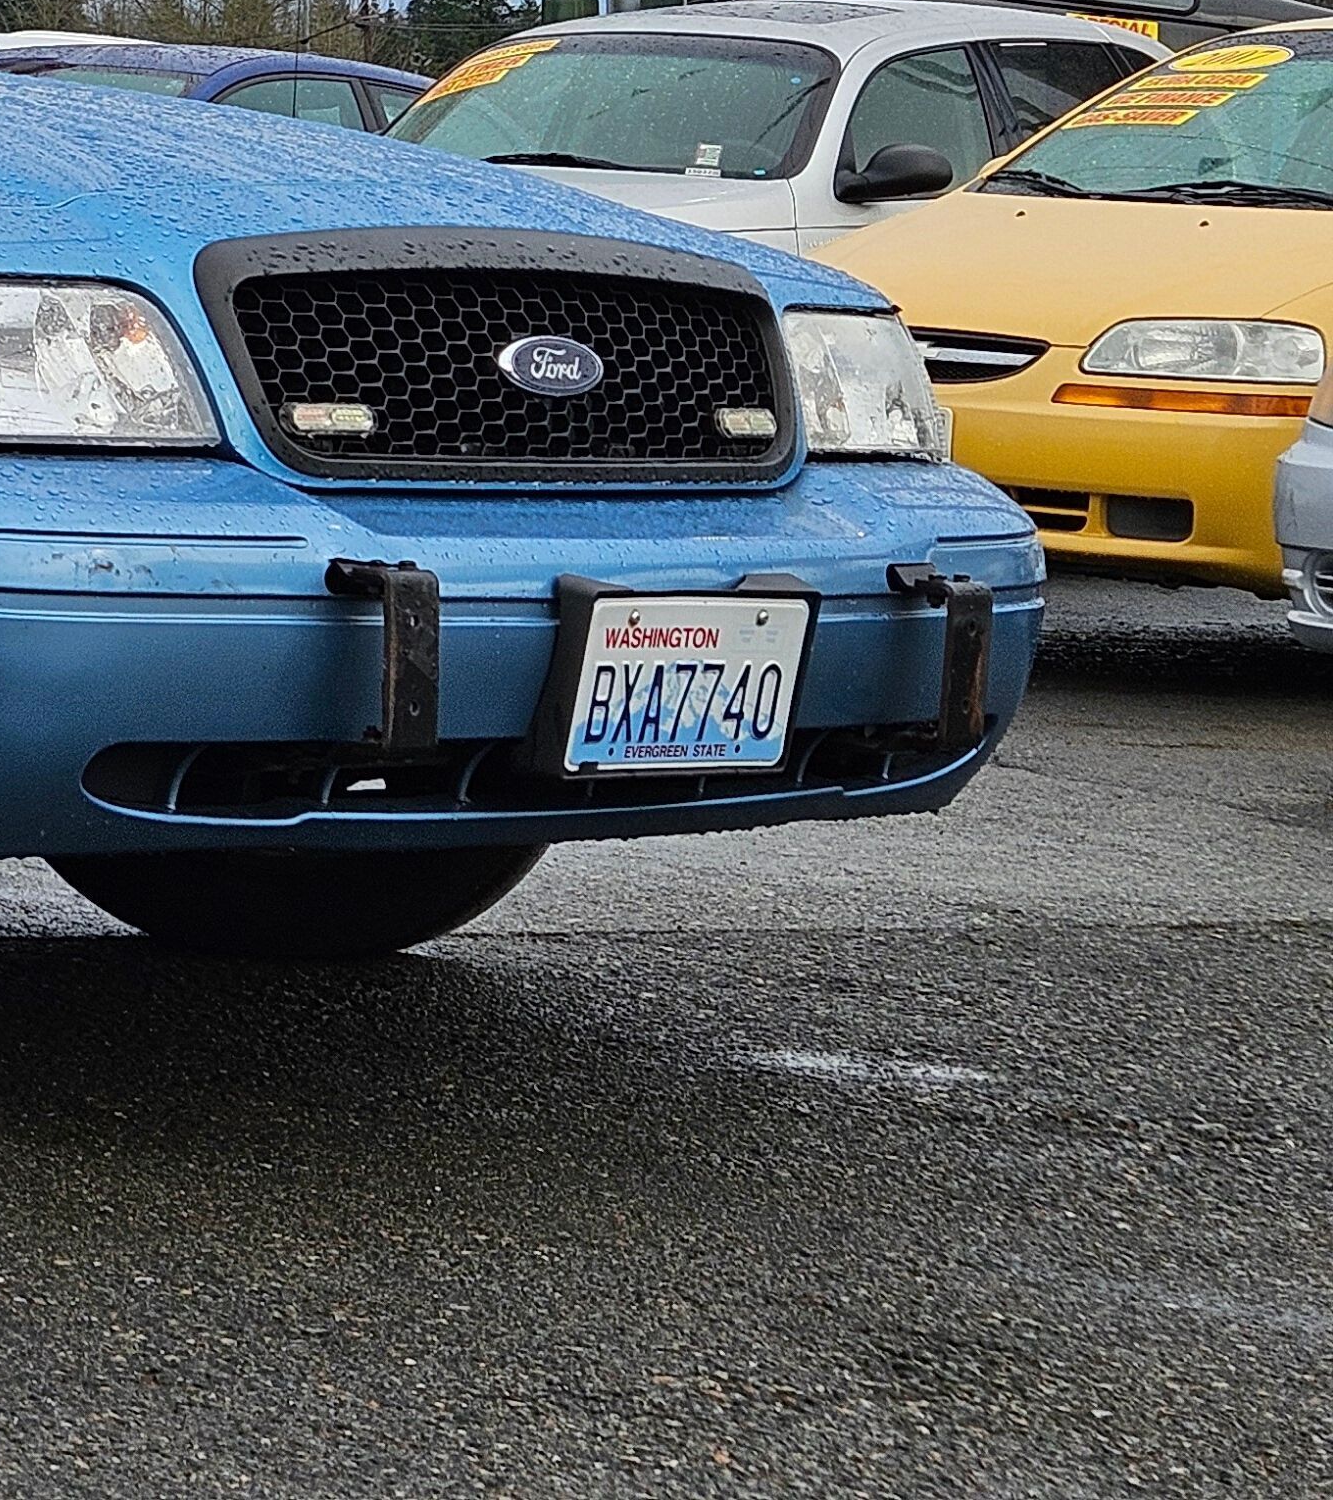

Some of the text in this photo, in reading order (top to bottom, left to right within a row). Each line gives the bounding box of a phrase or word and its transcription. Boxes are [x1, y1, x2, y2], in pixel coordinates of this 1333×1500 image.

[530, 346, 582, 380] Ford
[605, 626, 720, 649] WASHINGTON
[583, 662, 783, 744] BXA7740
[624, 743, 727, 760] EVERGREEN STATE
